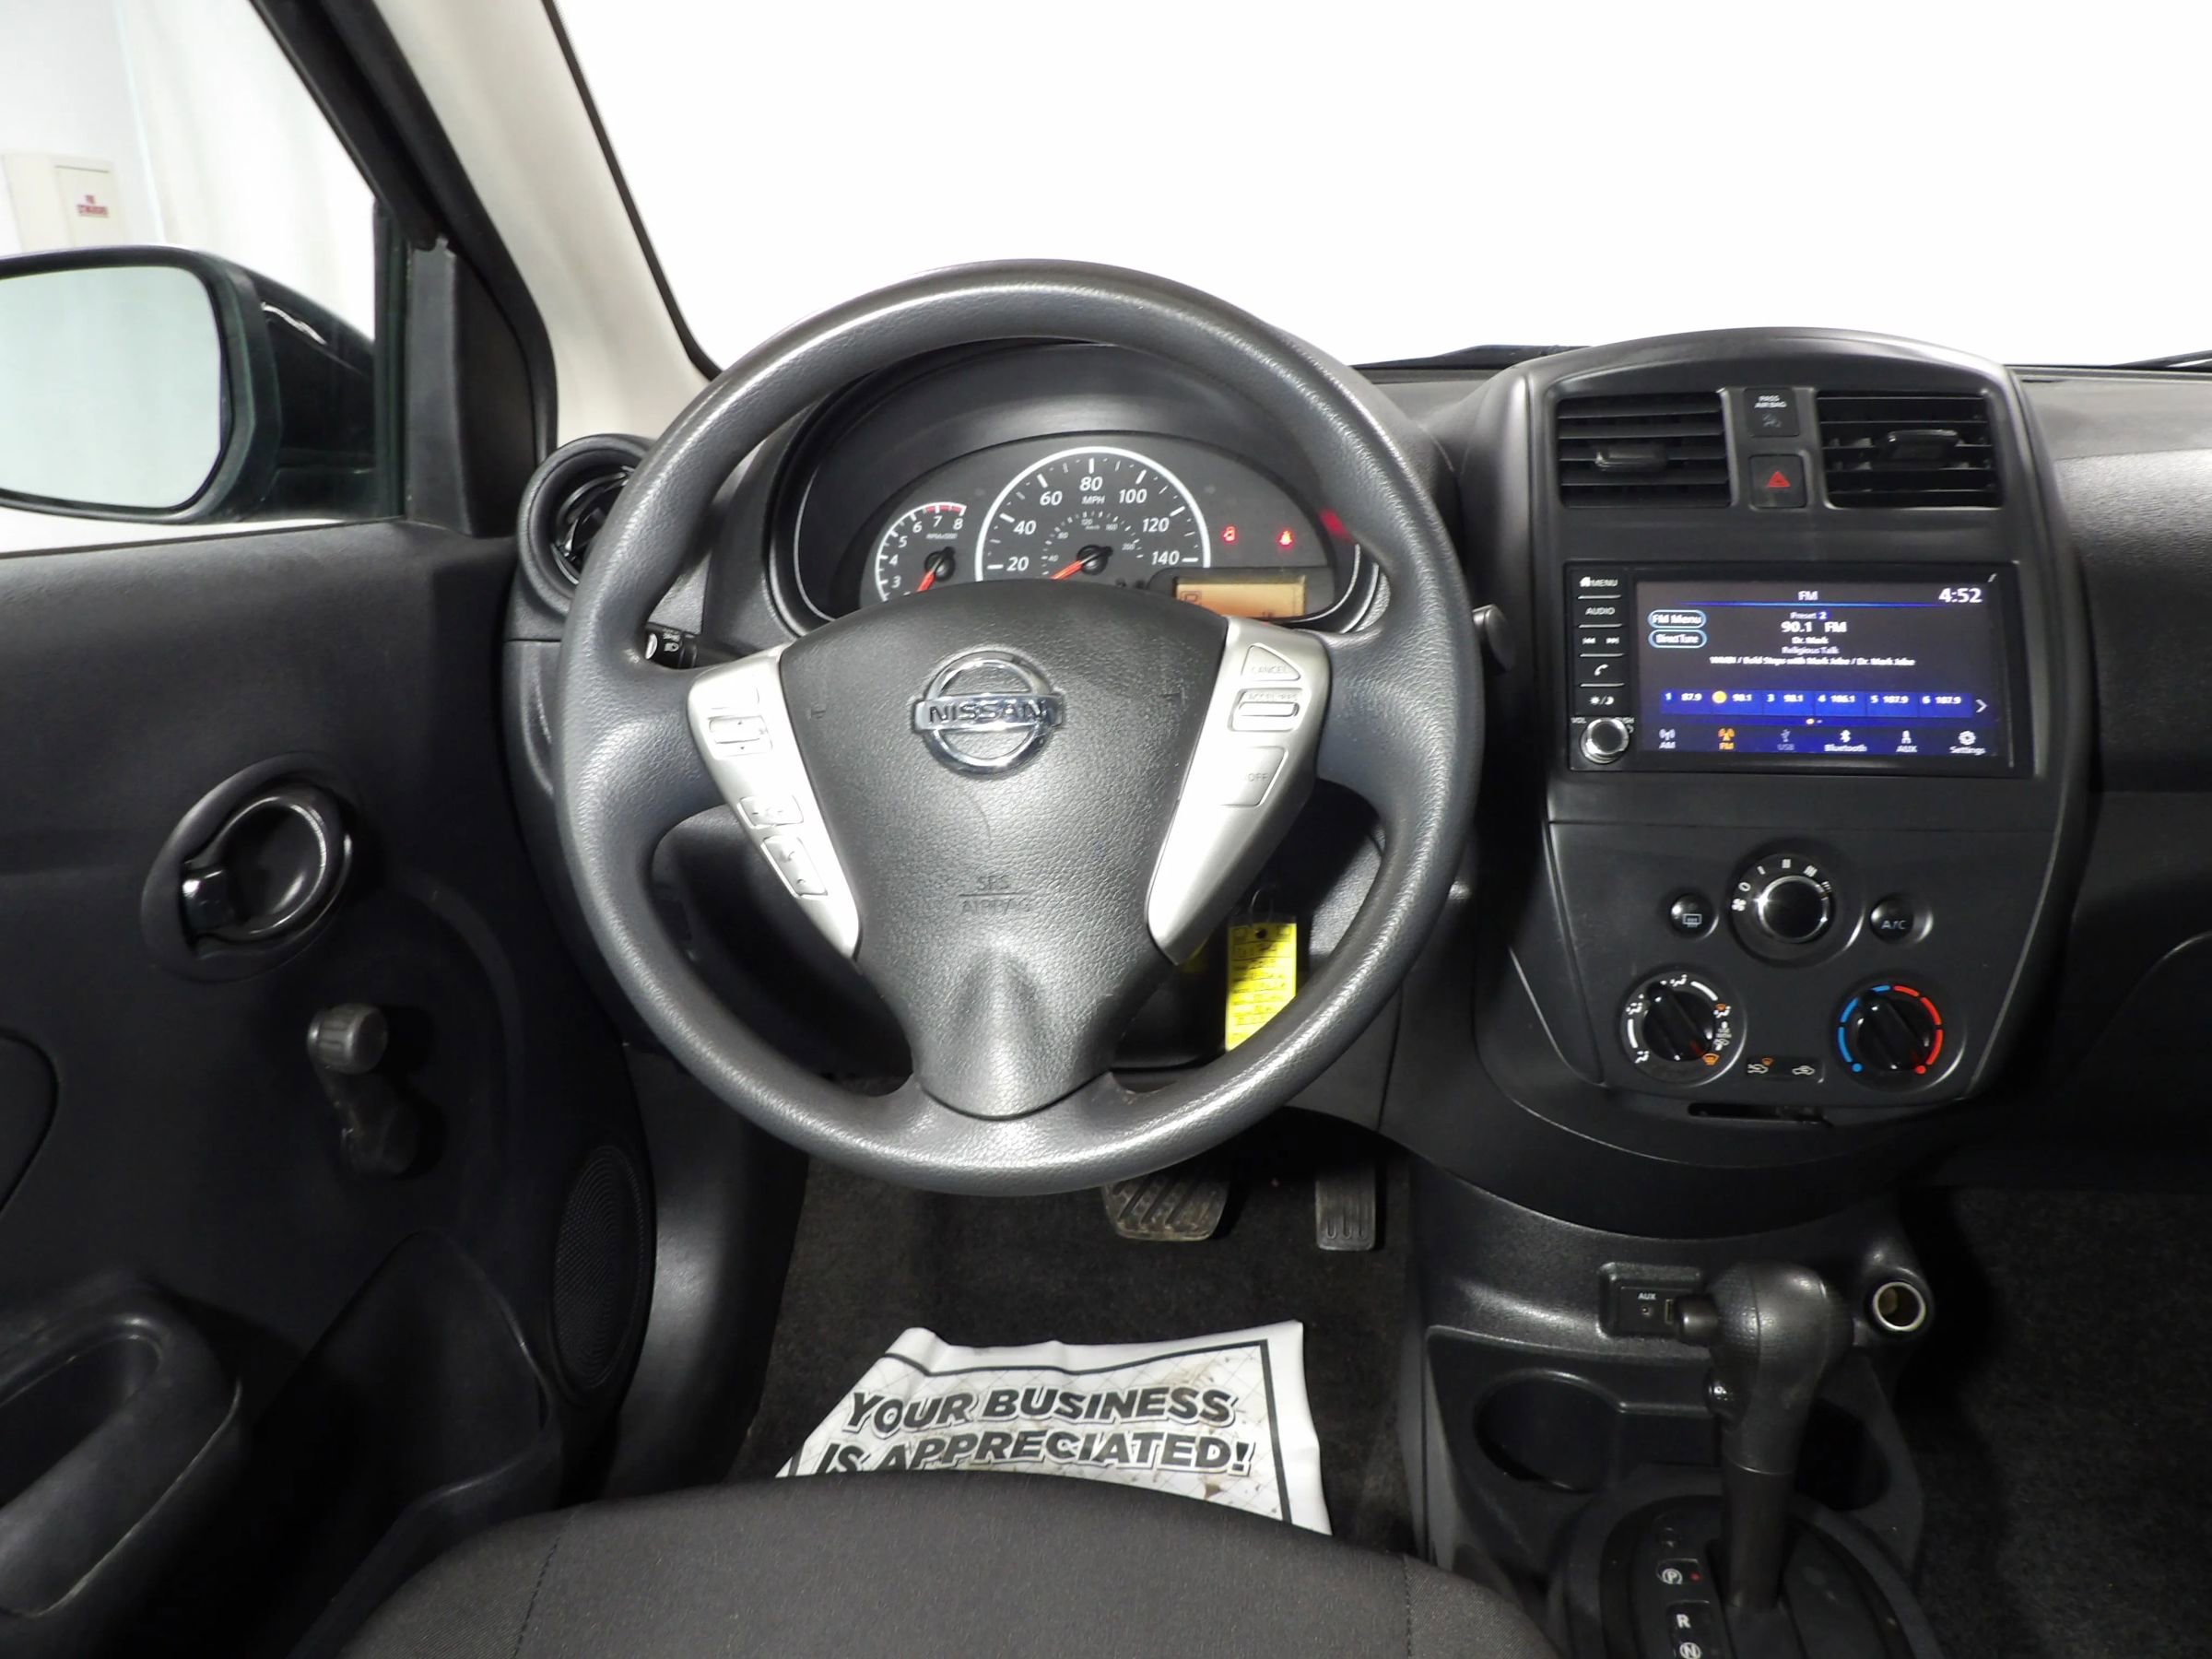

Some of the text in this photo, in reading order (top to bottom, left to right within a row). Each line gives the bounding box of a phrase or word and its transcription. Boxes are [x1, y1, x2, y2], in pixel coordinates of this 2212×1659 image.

[1079, 476, 1103, 491] 80
[1040, 490, 1063, 506] 60
[1081, 495, 1105, 505] MPH
[1118, 488, 1147, 504] 100
[933, 515, 943, 527] 7
[953, 518, 963, 530] 8
[1142, 517, 1170, 533] 120
[912, 521, 923, 534] 6
[1013, 520, 1037, 535] 40
[898, 535, 908, 547] 5
[888, 554, 899, 566] 4
[1006, 556, 1030, 571] 20
[1151, 550, 1180, 566] 140
[891, 575, 901, 588] 3
[1590, 579, 1618, 587] MENU
[1798, 591, 1818, 600] FM
[1938, 588, 1983, 603] 4:52
[1585, 606, 1616, 616] AUDIO
[1790, 611, 1828, 620] Preset 2
[1652, 614, 1702, 624] FM Menu
[1781, 620, 1848, 632] 90.1 FM
[1665, 692, 1703, 701] 1 87.9
[1767, 693, 1776, 702] 3
[1818, 694, 1827, 702] 4
[1869, 695, 1878, 703] 5
[1921, 695, 1931, 704] 6
[929, 699, 1047, 724] NISSAN
[1659, 741, 1676, 749] AM
[1719, 742, 1735, 750] FM
[1777, 743, 1794, 751] USB
[1824, 744, 1868, 753] Bluetooth
[1895, 745, 1918, 753] AUX
[1948, 746, 1986, 756] Settings
[1881, 920, 1907, 930] A/C
[845, 1385, 1235, 1435] YOUR BUSINESS
[814, 1430, 1252, 1474] IS APPRECIATED!
[1677, 1614, 1691, 1629] R
